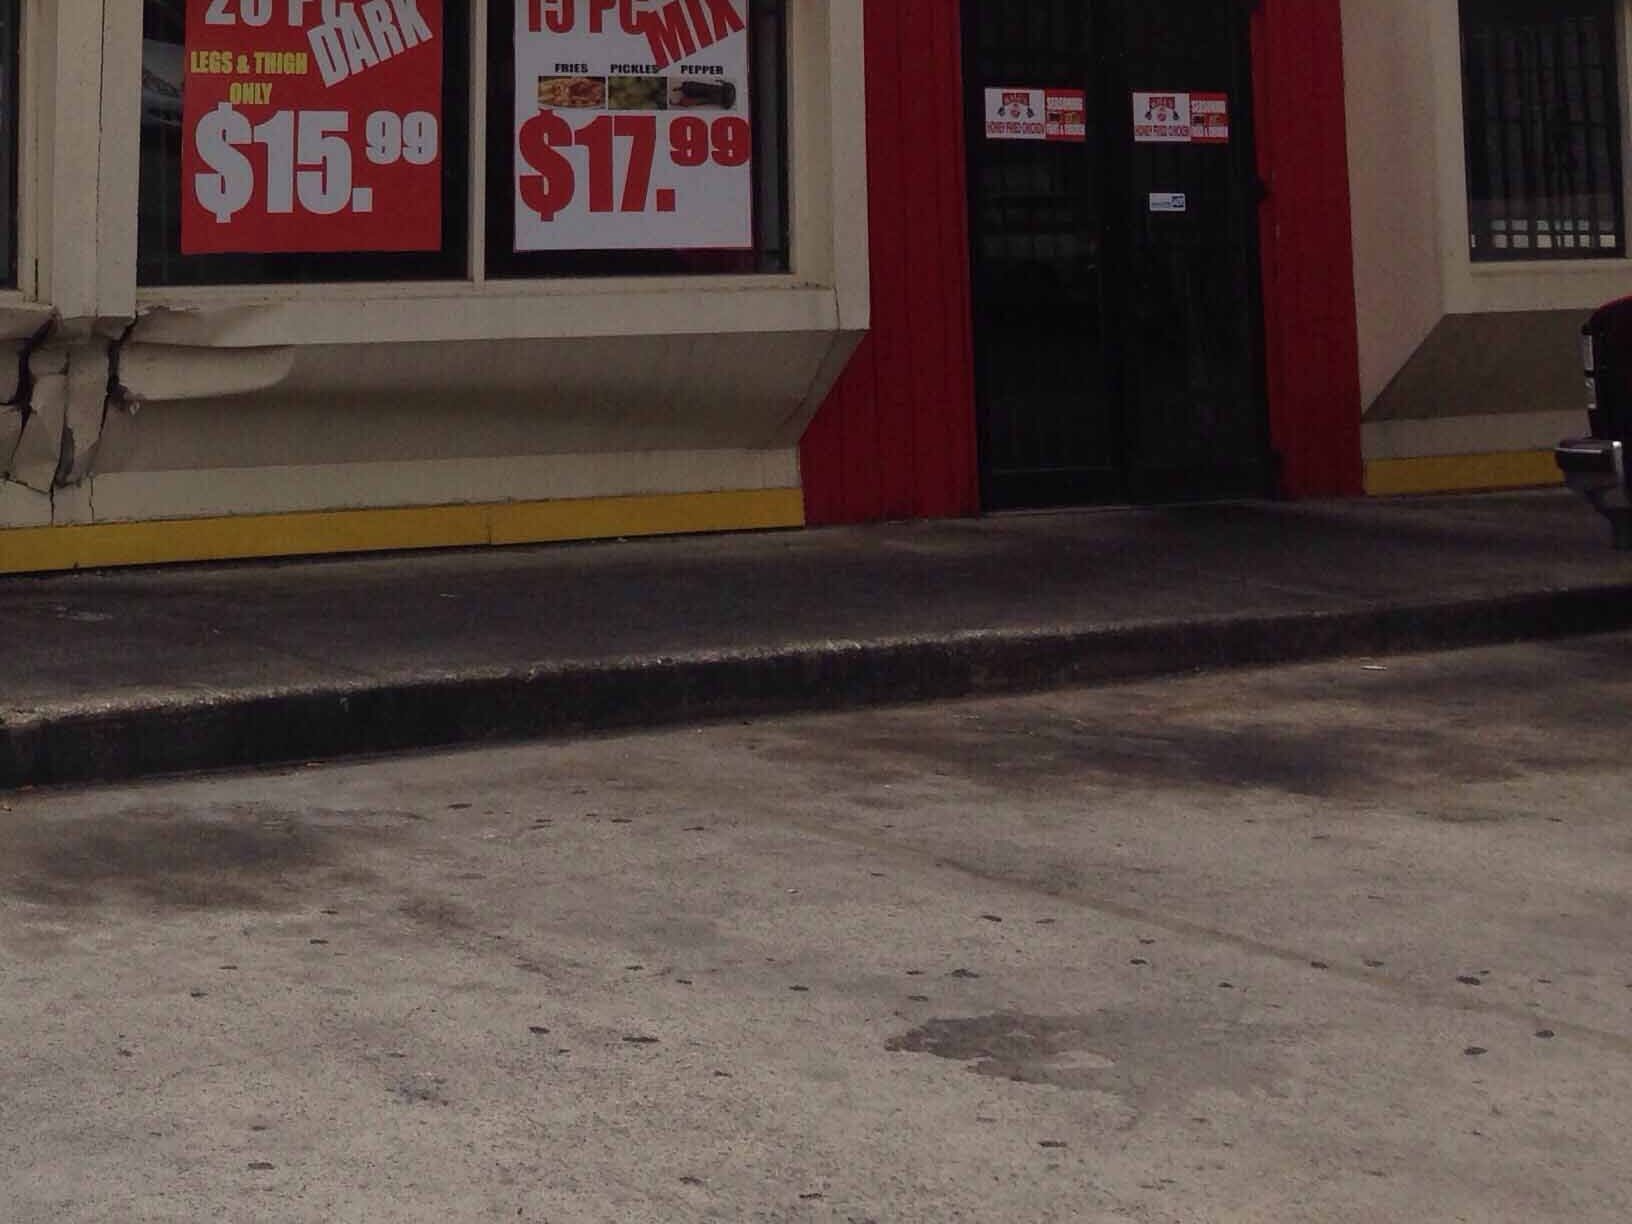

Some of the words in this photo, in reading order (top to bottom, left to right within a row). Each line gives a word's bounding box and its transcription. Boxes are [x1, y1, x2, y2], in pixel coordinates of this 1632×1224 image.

[190, 51, 233, 74] LEGS
[236, 54, 250, 74] &
[254, 51, 308, 75] THIGH
[555, 63, 588, 74] FRIES
[610, 64, 659, 74] PICKLES
[680, 64, 723, 76] PEPPER
[230, 82, 273, 105] ONLY
